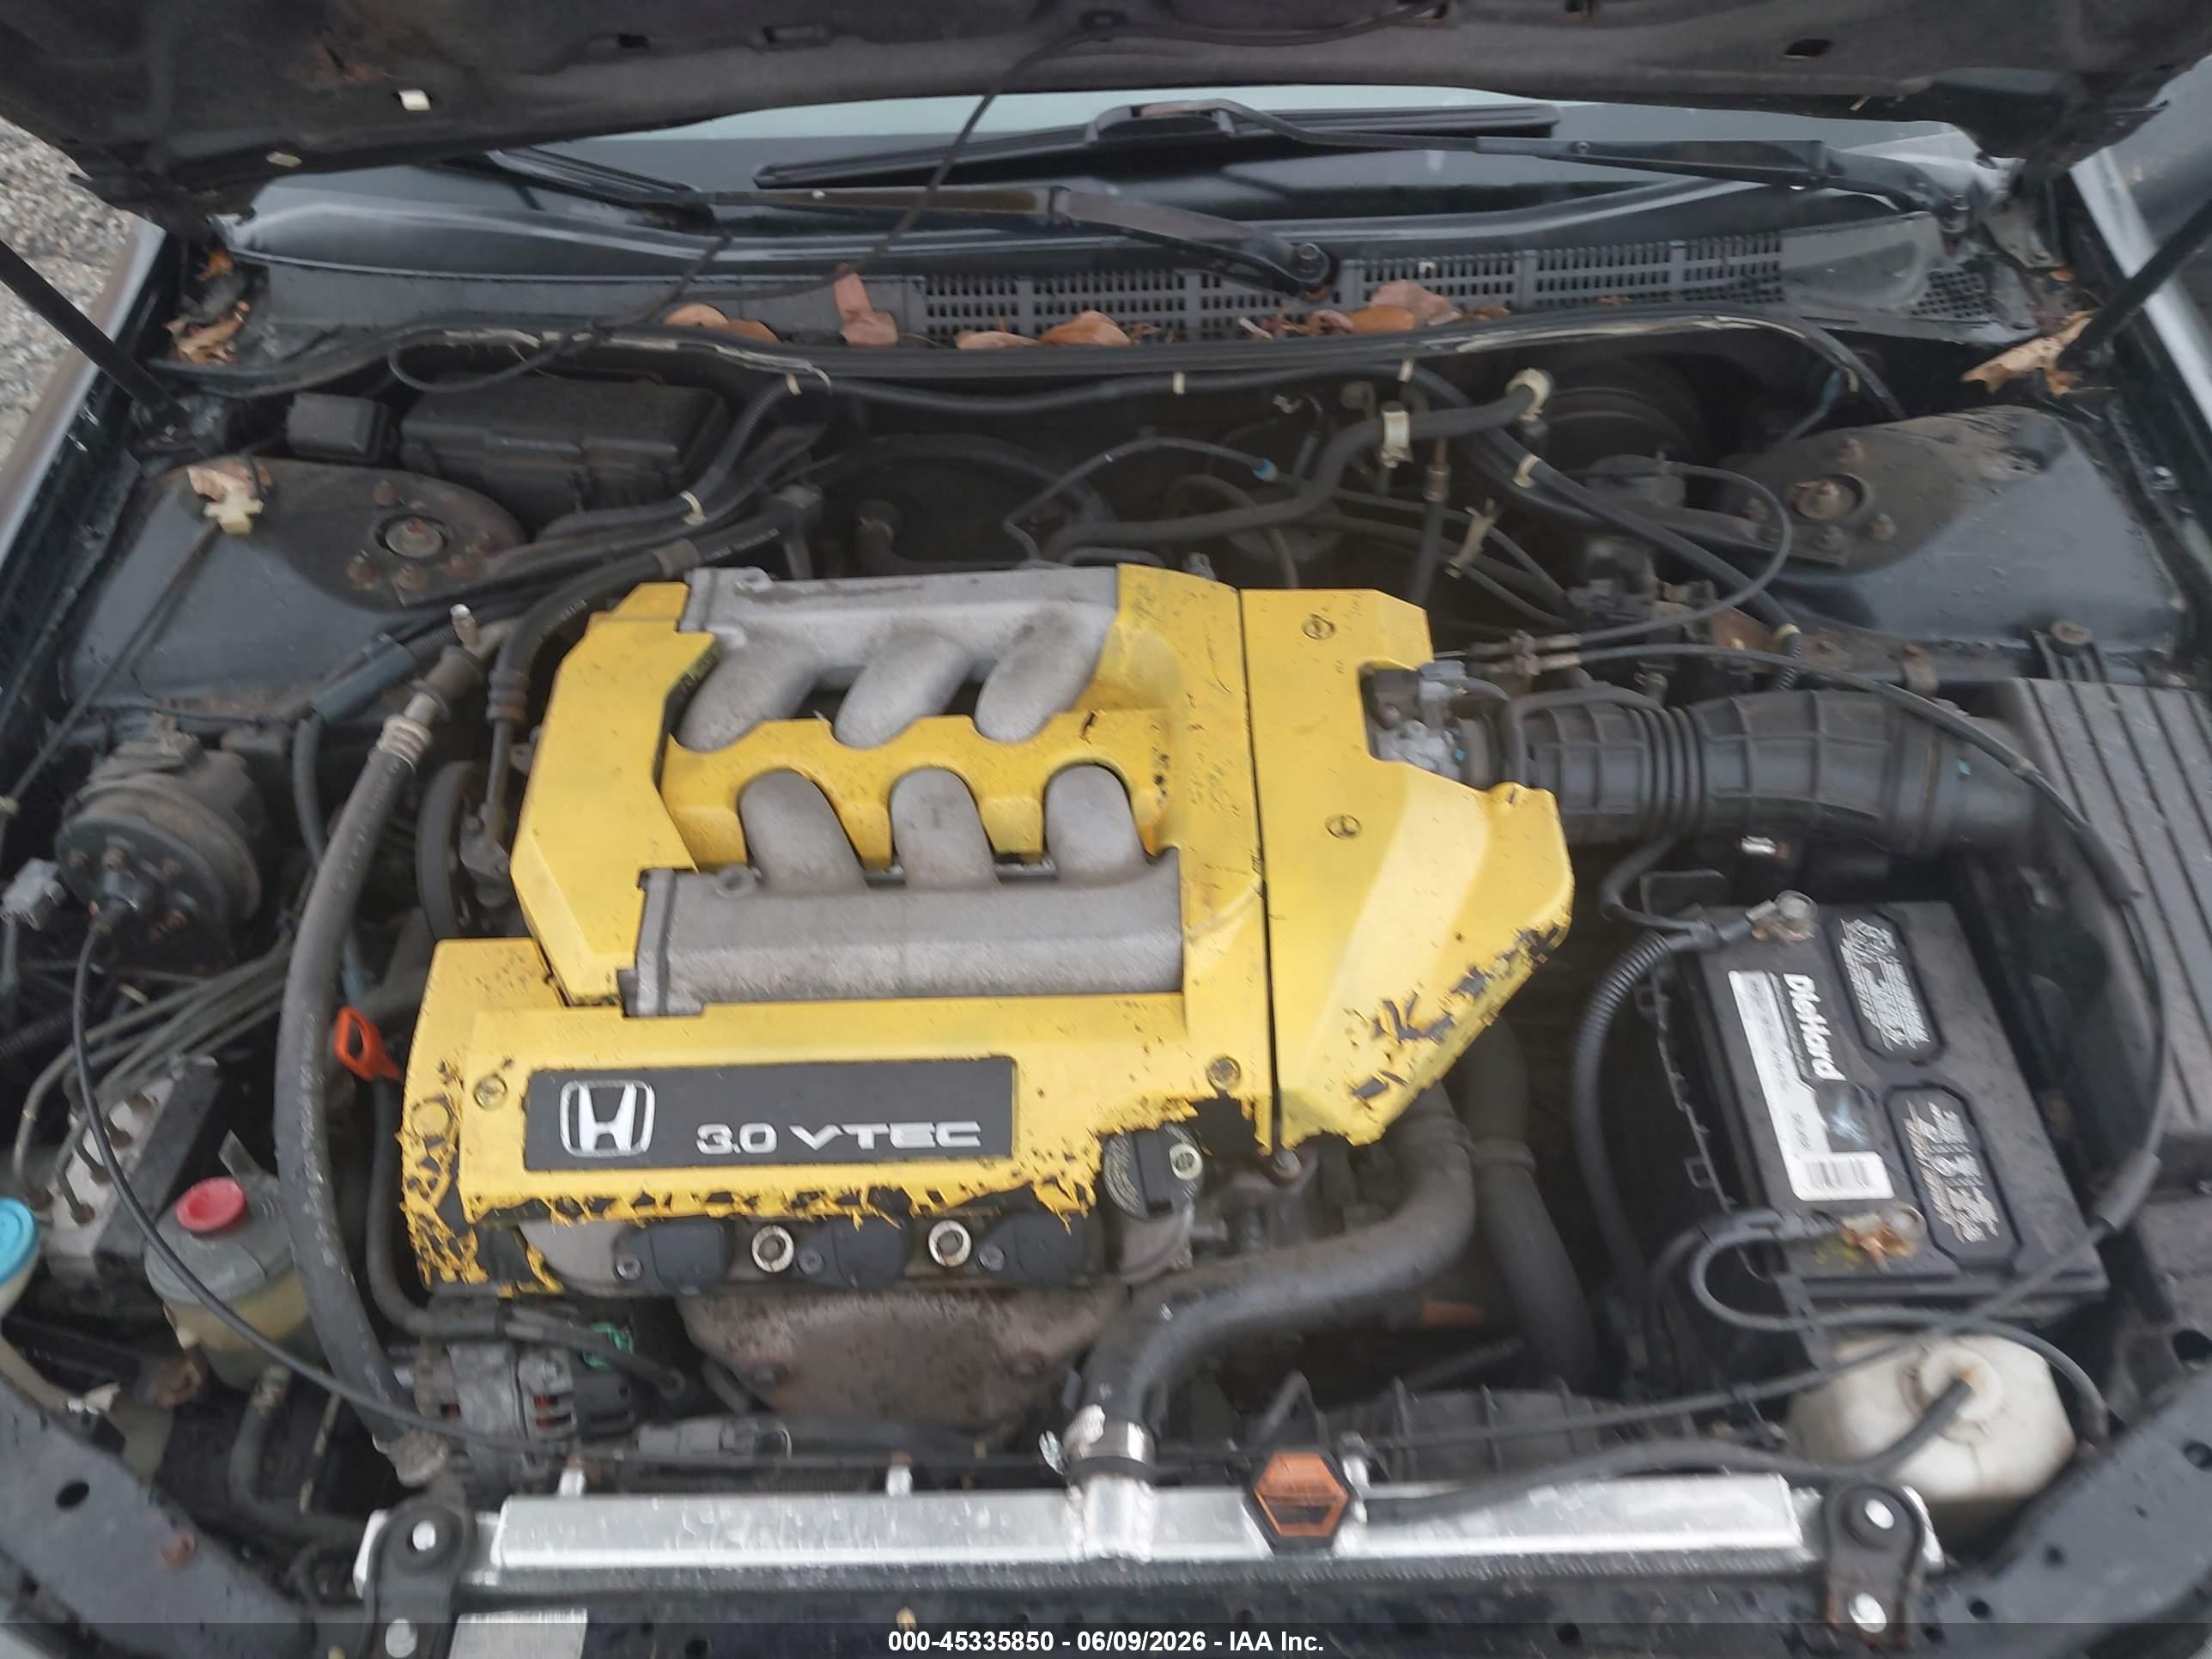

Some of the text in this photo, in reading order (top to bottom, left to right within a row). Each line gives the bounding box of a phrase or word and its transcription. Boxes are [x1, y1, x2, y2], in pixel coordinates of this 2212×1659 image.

[1783, 973, 1848, 1082] DieHard
[696, 1120, 981, 1155] 3.0 VTEC
